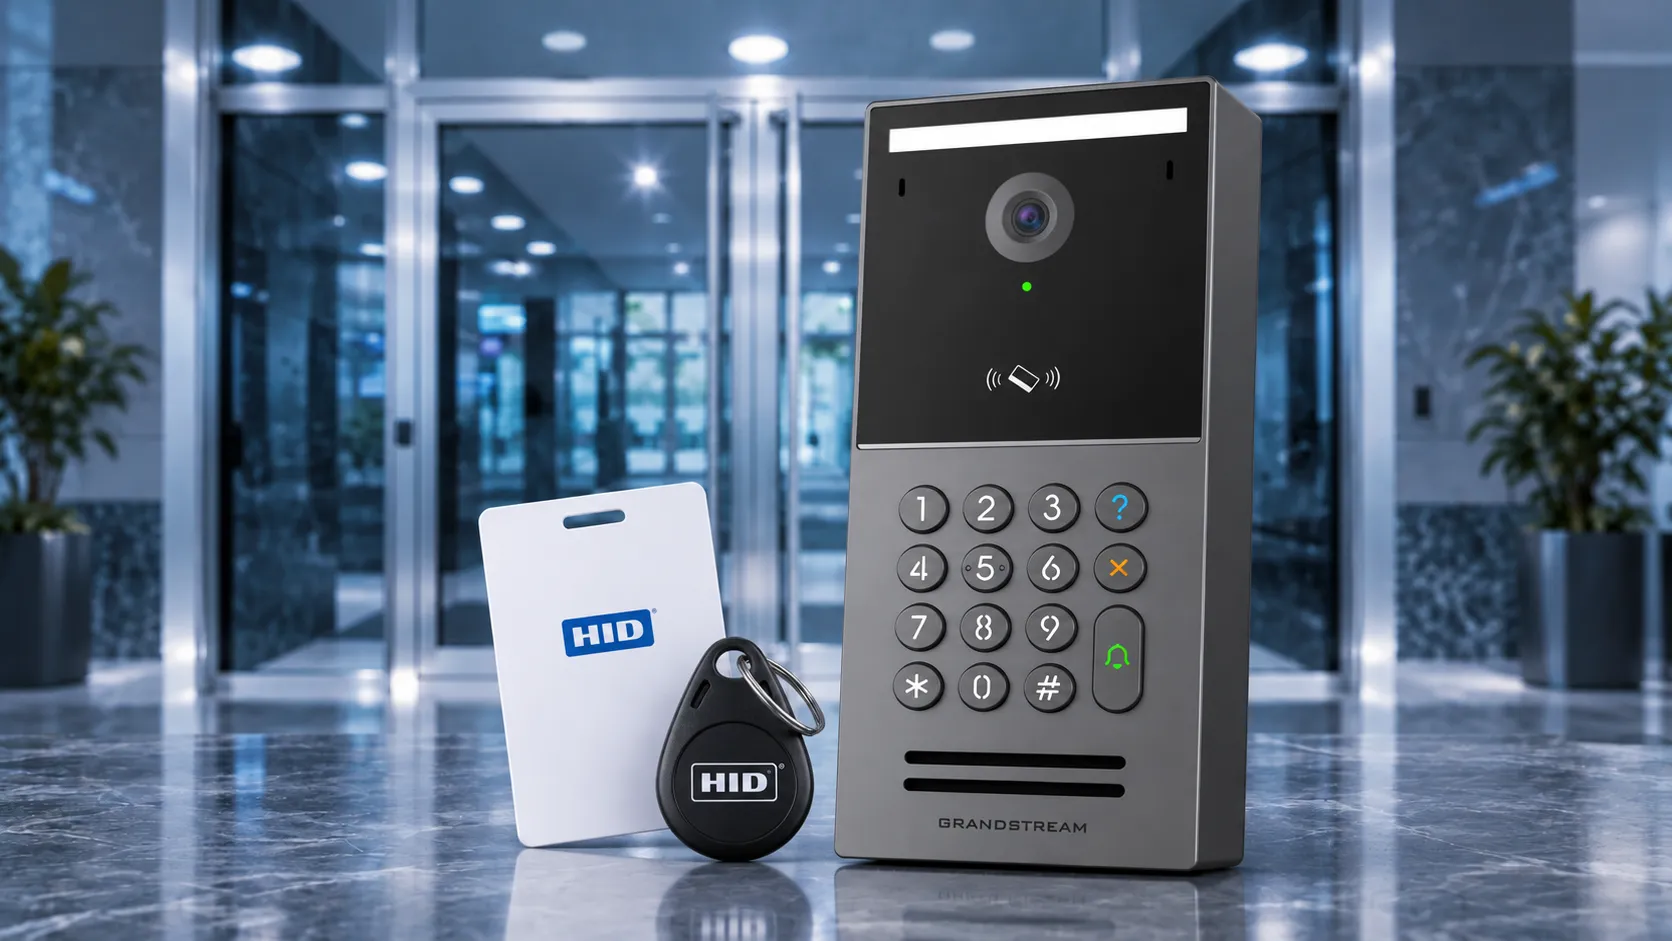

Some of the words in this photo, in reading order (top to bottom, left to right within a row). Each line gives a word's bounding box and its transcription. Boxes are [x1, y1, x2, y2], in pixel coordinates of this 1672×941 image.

[917, 496, 925, 521] 1
[977, 495, 996, 521] 2
[1043, 494, 1061, 521] 3
[909, 555, 928, 581] 4
[976, 555, 995, 581] 5
[1042, 555, 1060, 581] 6
[572, 619, 644, 648] HID
[911, 615, 927, 640] 7
[975, 614, 992, 640] 8
[1040, 615, 1060, 641] 9
[973, 674, 991, 700] 0
[701, 773, 768, 792] HID
[938, 817, 1088, 834] GRANDSTREAM
